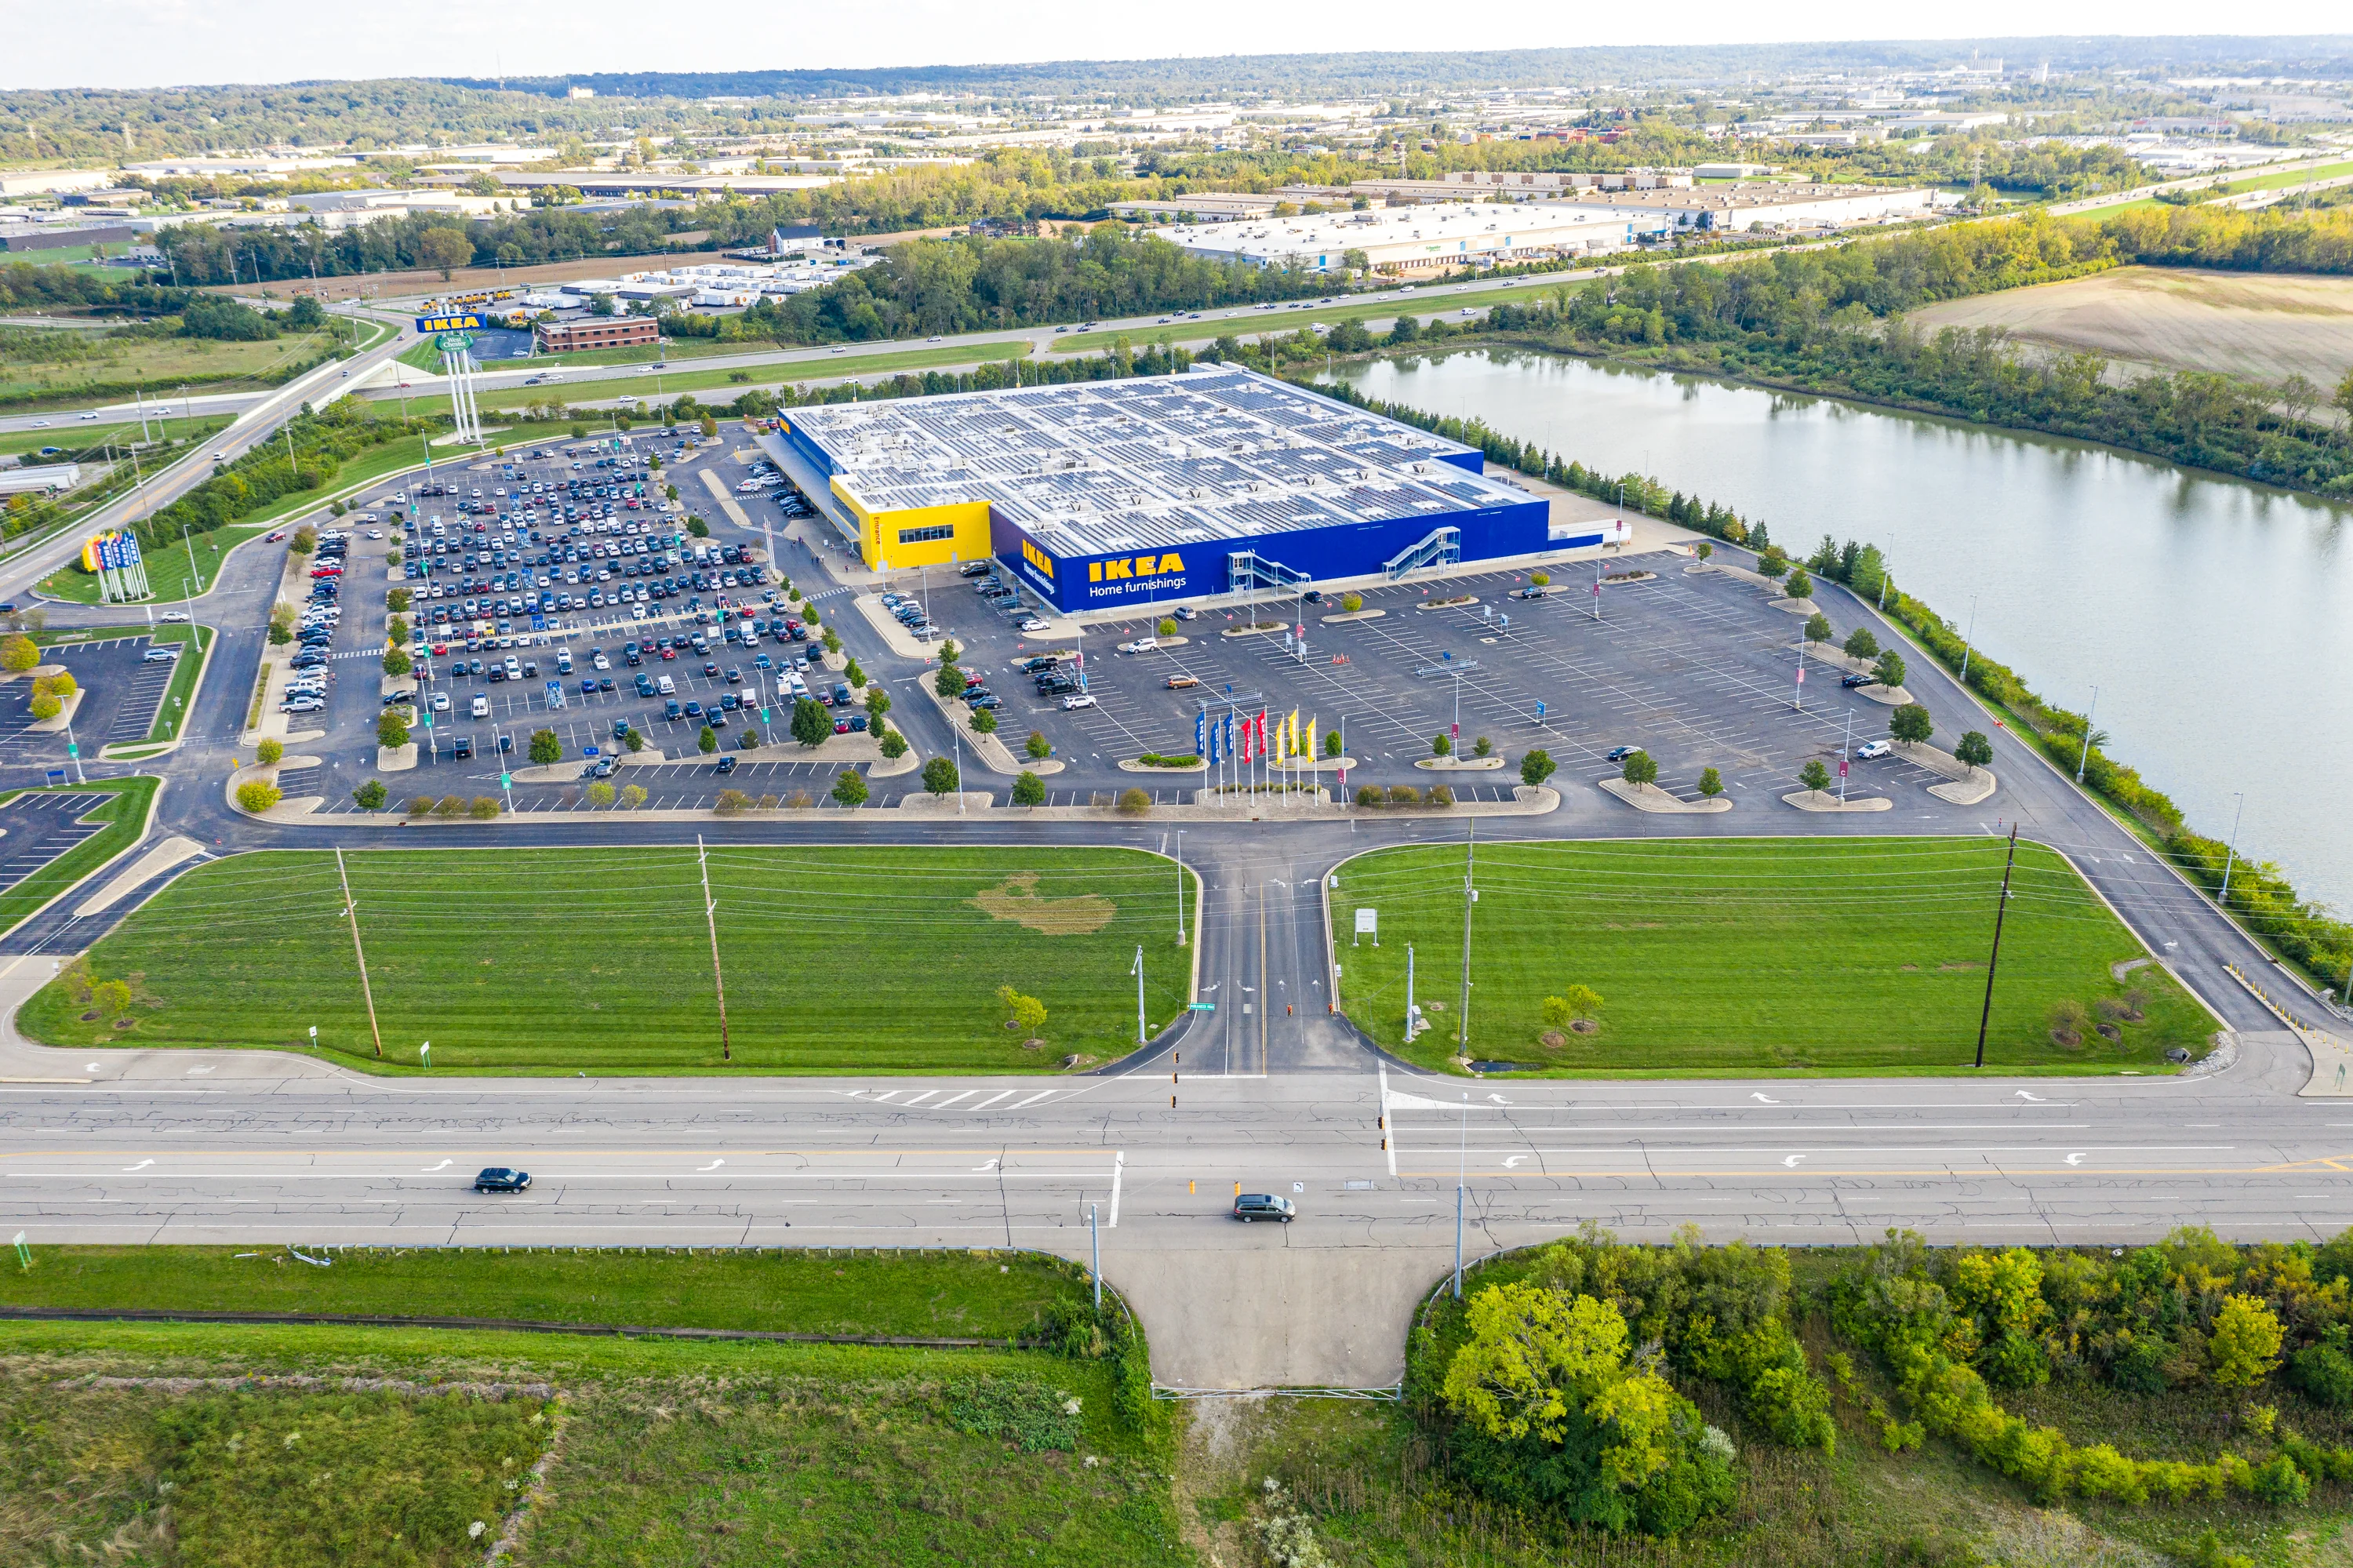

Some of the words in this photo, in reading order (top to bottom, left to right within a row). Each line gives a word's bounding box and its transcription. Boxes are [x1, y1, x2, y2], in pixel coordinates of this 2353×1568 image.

[424, 317, 480, 331] IKEA
[1022, 539, 1054, 578] IKEA
[1089, 553, 1185, 582] IKEA
[1090, 586, 1122, 597] Home
[1126, 577, 1186, 593] furnishings
